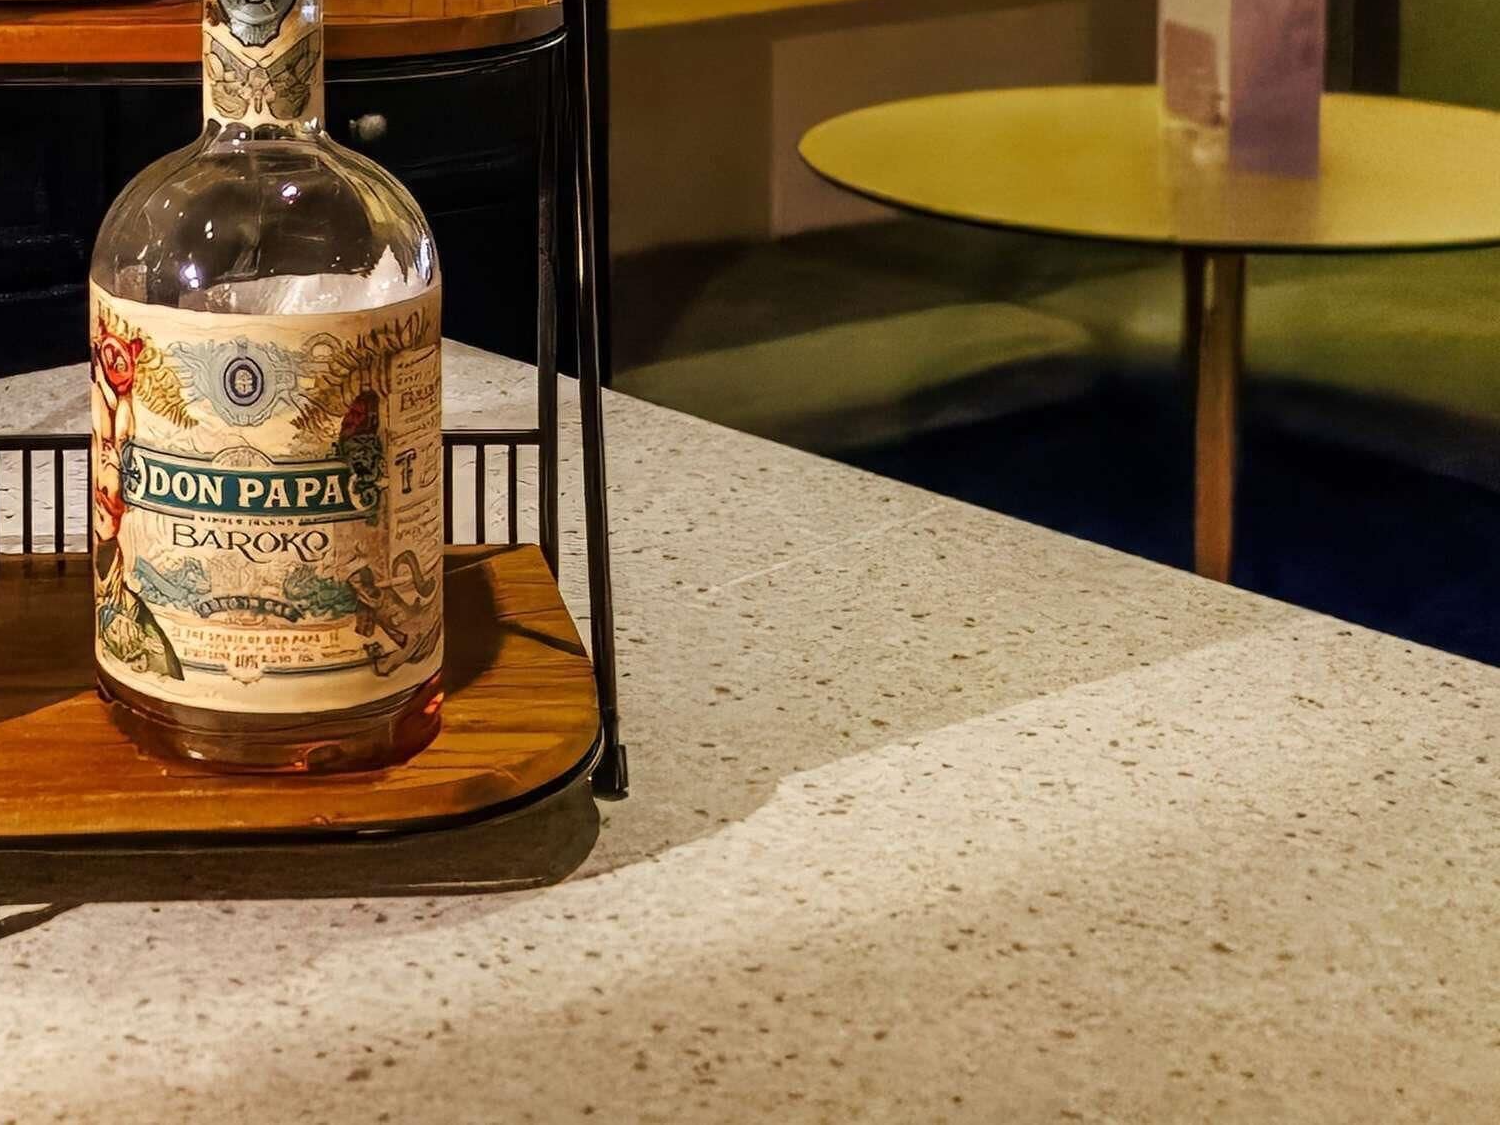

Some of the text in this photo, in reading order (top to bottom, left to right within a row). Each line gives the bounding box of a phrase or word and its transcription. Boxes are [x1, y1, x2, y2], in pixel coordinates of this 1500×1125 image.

[149, 464, 346, 508] DON PAPA
[172, 523, 330, 564] BAROKO
